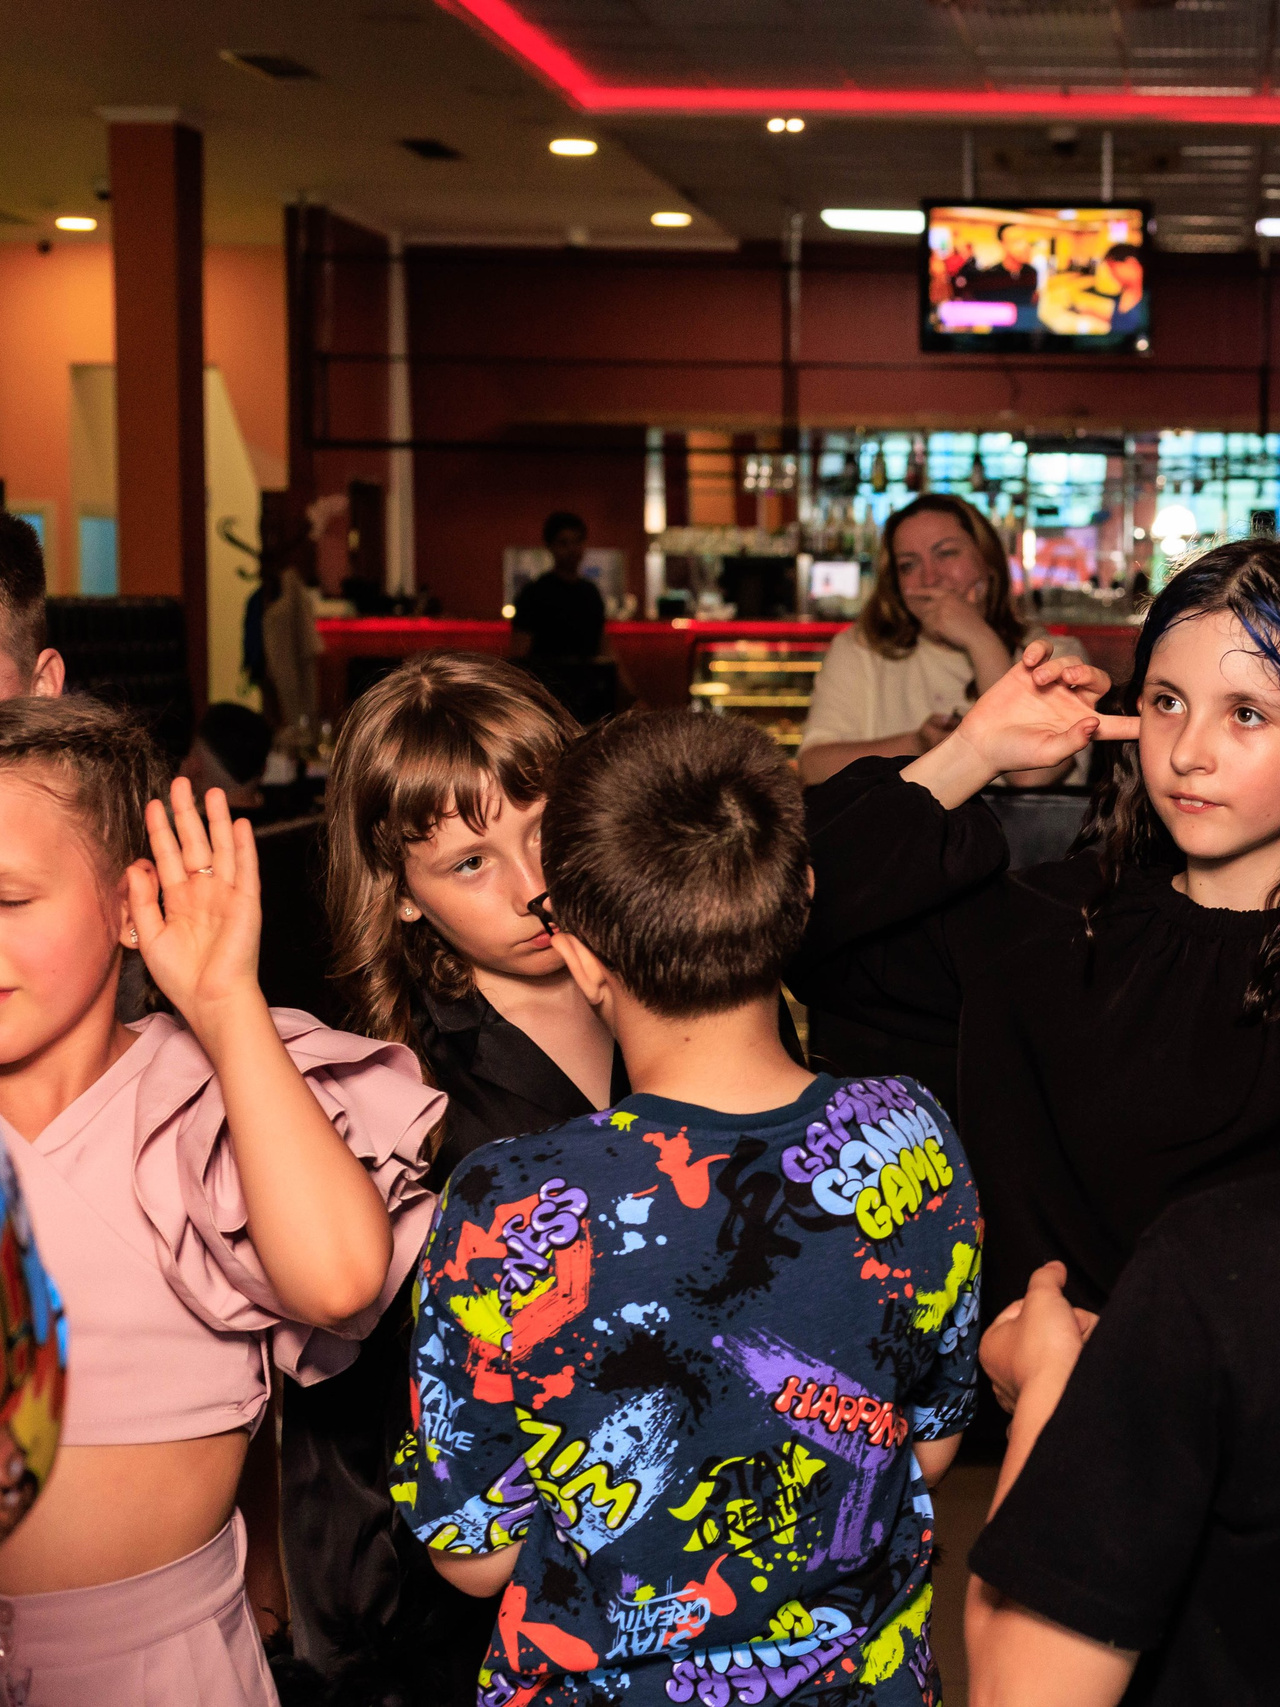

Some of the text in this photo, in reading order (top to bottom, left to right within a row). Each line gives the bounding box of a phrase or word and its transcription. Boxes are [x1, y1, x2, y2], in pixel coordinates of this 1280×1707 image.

[780, 1078, 917, 1184] GAMERS
[811, 1104, 944, 1216] GONNA
[854, 1137, 954, 1240] GAME
[417, 1369, 467, 1421] TAY
[697, 1472, 834, 1551] CREATIVE
[698, 1436, 799, 1506] STAY
